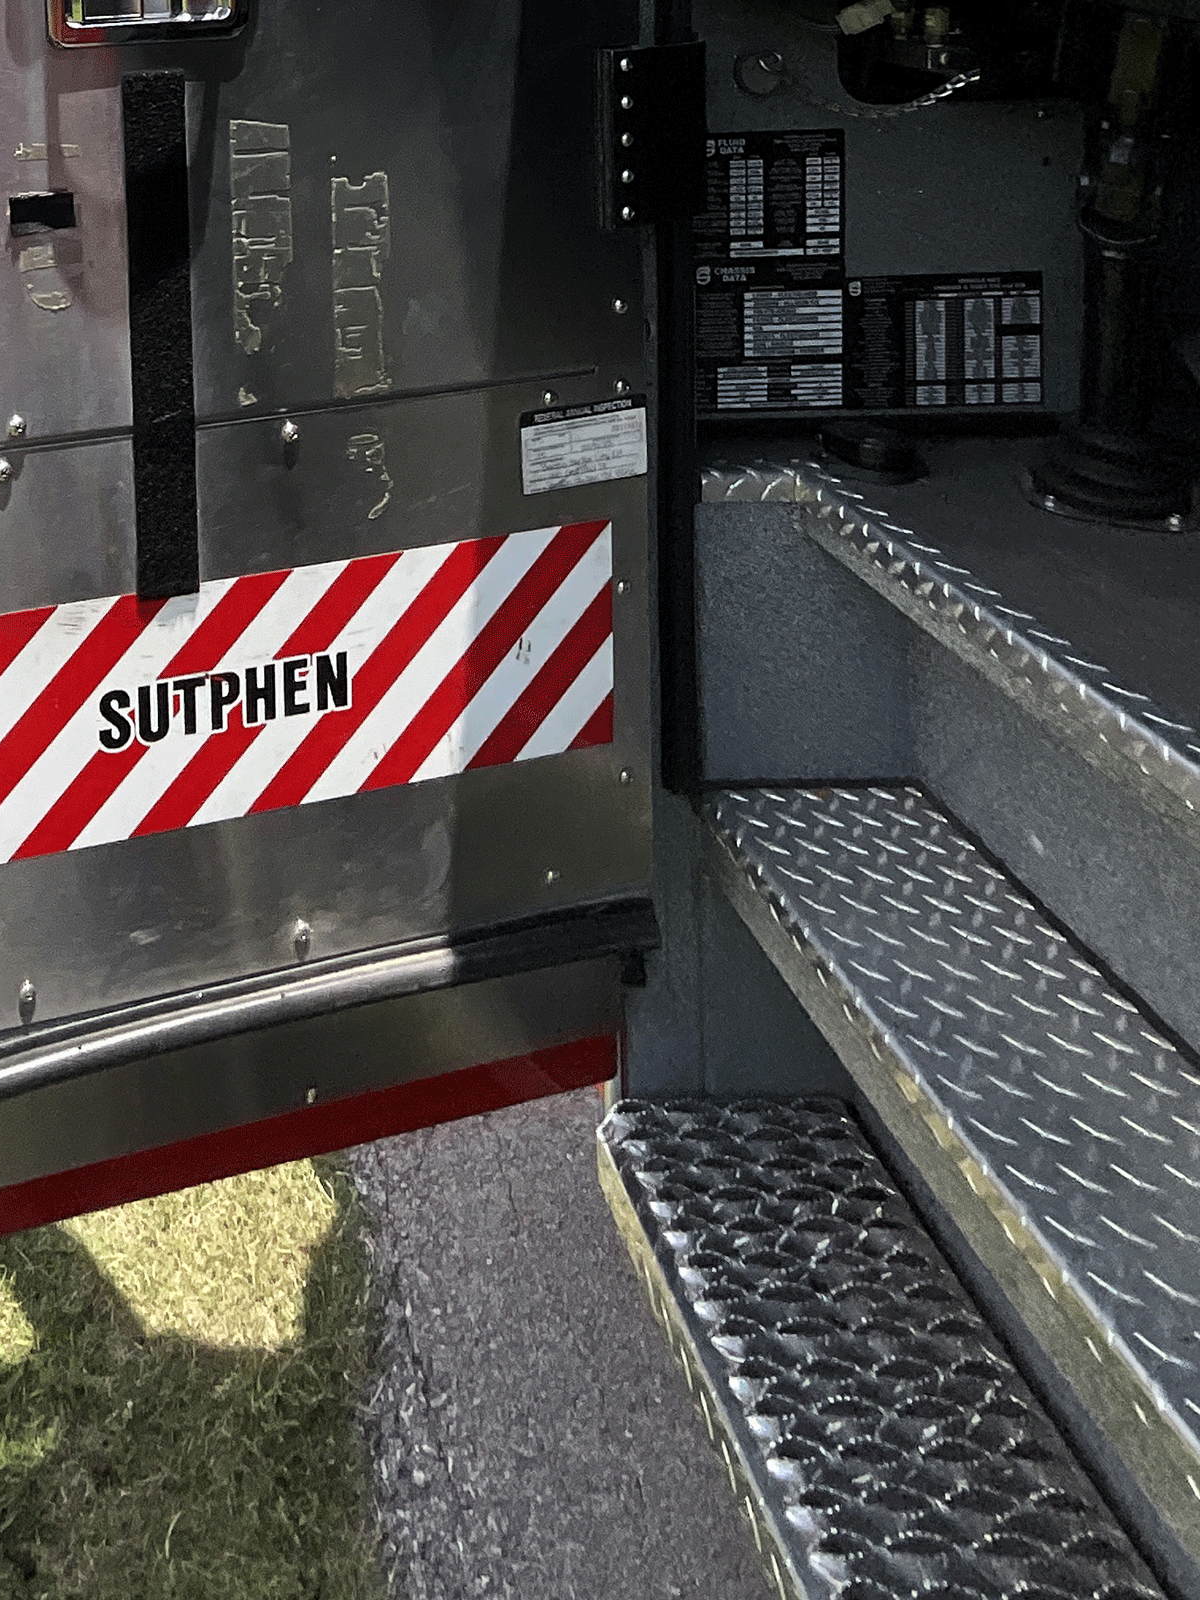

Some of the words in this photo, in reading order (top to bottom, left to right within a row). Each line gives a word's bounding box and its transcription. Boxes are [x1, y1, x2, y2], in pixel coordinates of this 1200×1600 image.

[719, 146, 744, 154] DATA
[722, 274, 747, 282] DATA
[99, 651, 347, 749] SUTPHEN
